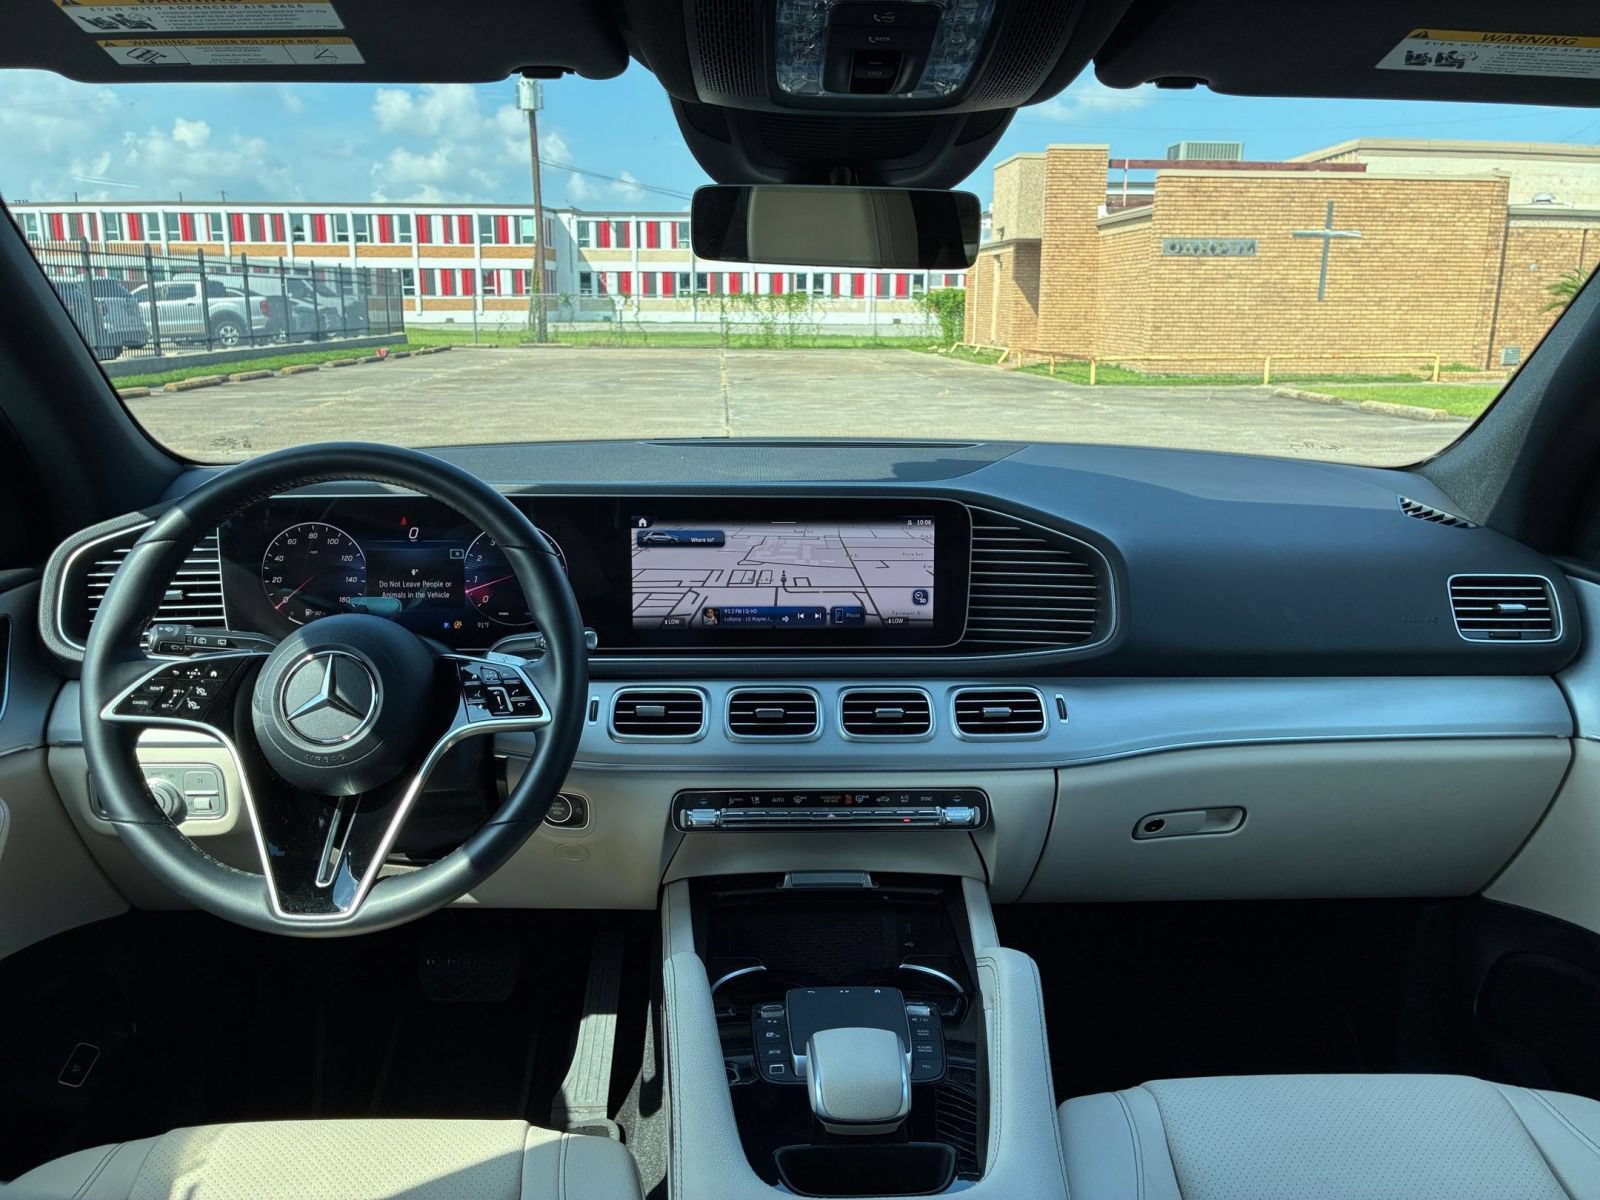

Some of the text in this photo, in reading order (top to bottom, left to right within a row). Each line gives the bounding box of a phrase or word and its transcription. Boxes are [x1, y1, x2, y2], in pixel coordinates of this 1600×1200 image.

[1481, 33, 1578, 46] WARNING
[1494, 44, 1557, 52] ADVANCED
[408, 527, 419, 539] 0
[271, 576, 282, 584] 20
[379, 580, 388, 588] Do
[389, 580, 401, 588] Not
[402, 580, 421, 588] Leave
[422, 580, 444, 588] People
[382, 591, 406, 599] Animals
[426, 591, 450, 599] Vehicle
[482, 595, 489, 603] 0
